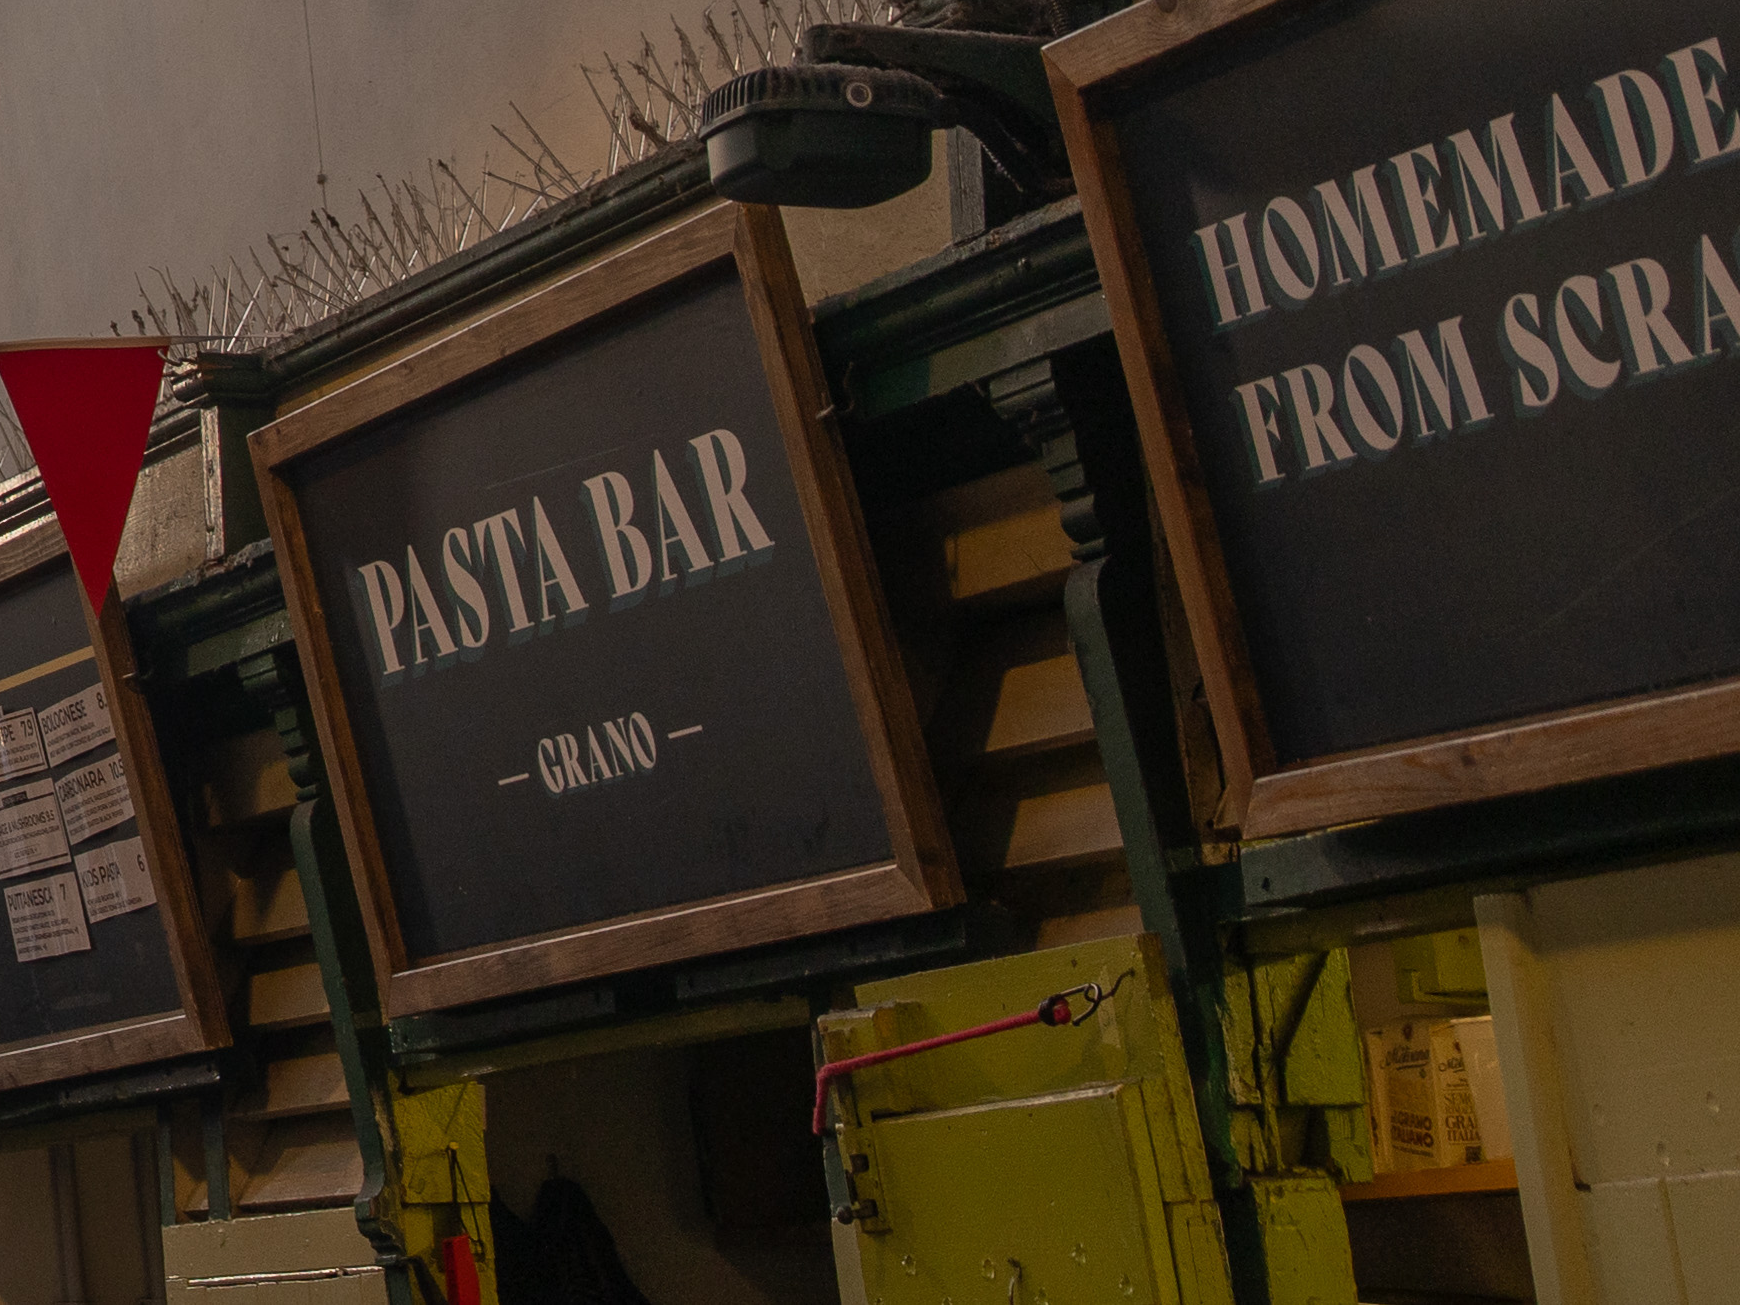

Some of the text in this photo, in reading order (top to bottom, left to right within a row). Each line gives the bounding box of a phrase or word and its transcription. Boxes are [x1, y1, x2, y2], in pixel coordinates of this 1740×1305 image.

[1192, 36, 1740, 327] HOMEMADE
[1234, 314, 1495, 484] FROM
[356, 427, 776, 677] PASTA BAR
[40, 699, 88, 736] BOLOGNESE
[536, 710, 658, 795] GRANO
[57, 767, 107, 803] CARBONARA
[136, 854, 146, 872] 6
[7, 883, 67, 912] PUTTANESCA 7
